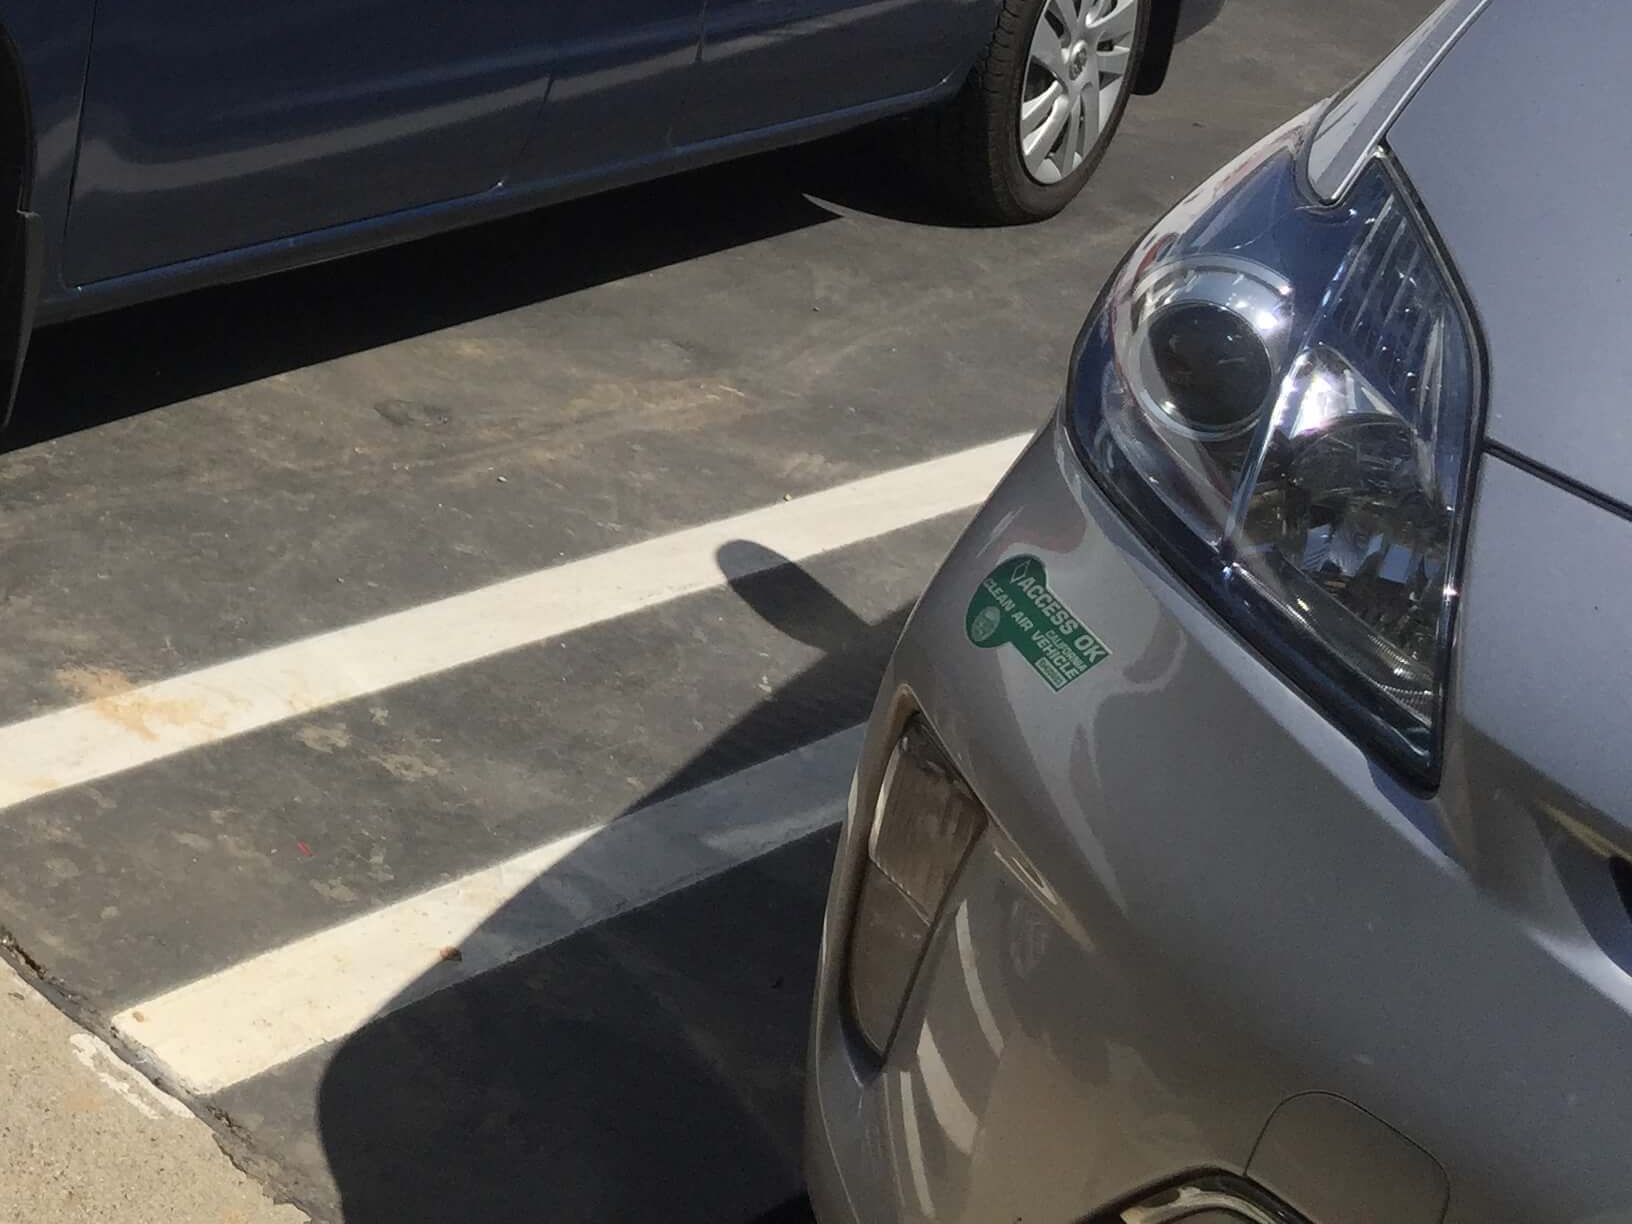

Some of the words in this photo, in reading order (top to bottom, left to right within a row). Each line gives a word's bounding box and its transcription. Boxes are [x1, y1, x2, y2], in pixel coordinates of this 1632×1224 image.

[983, 578, 1016, 612] CLEAN
[1012, 610, 1034, 632] AIR
[1032, 630, 1079, 680] VEHICLE
[1018, 576, 1079, 635] ACCESS
[1074, 634, 1107, 663] OK
